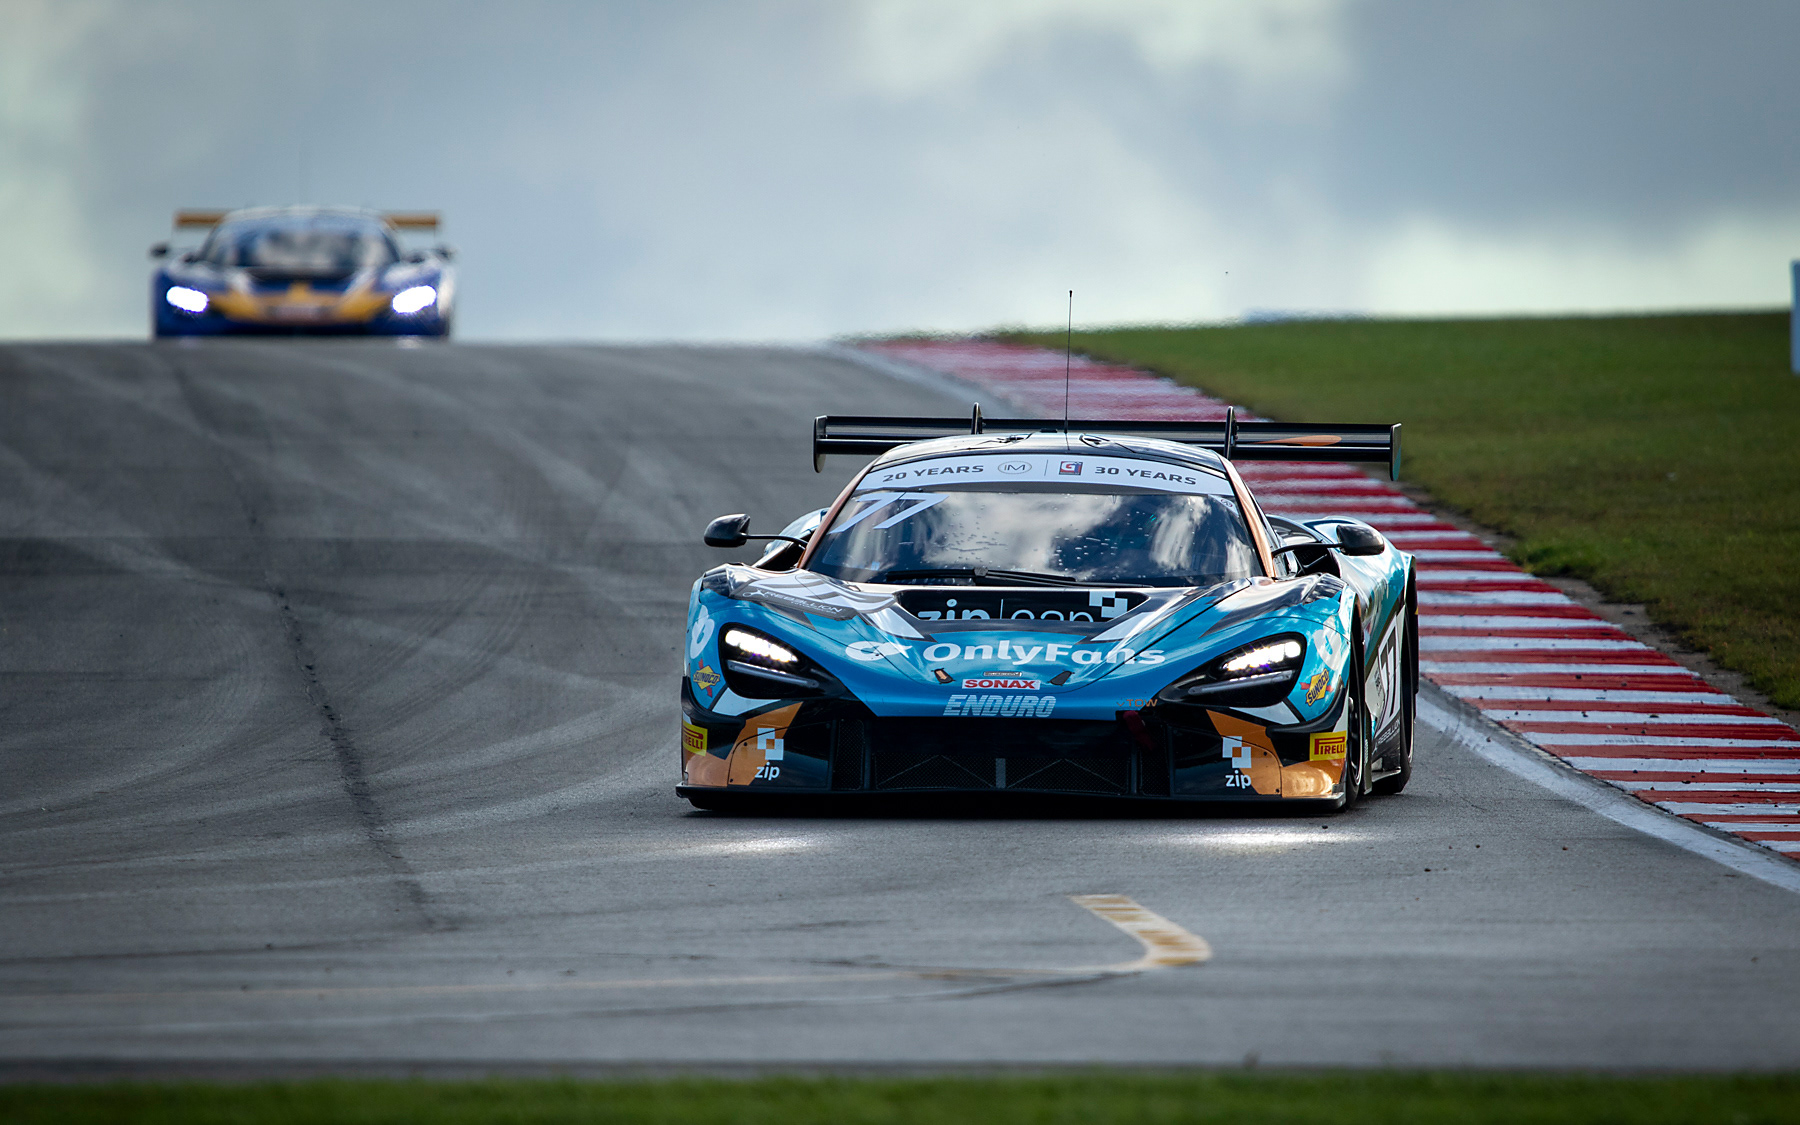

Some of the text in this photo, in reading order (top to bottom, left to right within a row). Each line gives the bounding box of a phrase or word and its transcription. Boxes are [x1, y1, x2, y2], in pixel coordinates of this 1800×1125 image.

[882, 465, 984, 482] 20 YEARS
[1094, 466, 1197, 485] 30 YEARS
[828, 492, 950, 534] 77
[764, 591, 843, 613] REBELLION
[922, 640, 1166, 666] OnlyFans
[694, 671, 719, 684] SUNOCO
[963, 679, 1036, 690] SONAX
[1306, 668, 1330, 705] SUNOCO
[942, 694, 1057, 718] ENDURO
[1126, 698, 1158, 708] TOW
[683, 726, 704, 750] RELLI
[1314, 736, 1345, 755] PIRELLI
[754, 761, 780, 781] zip
[1225, 769, 1252, 789] zip
